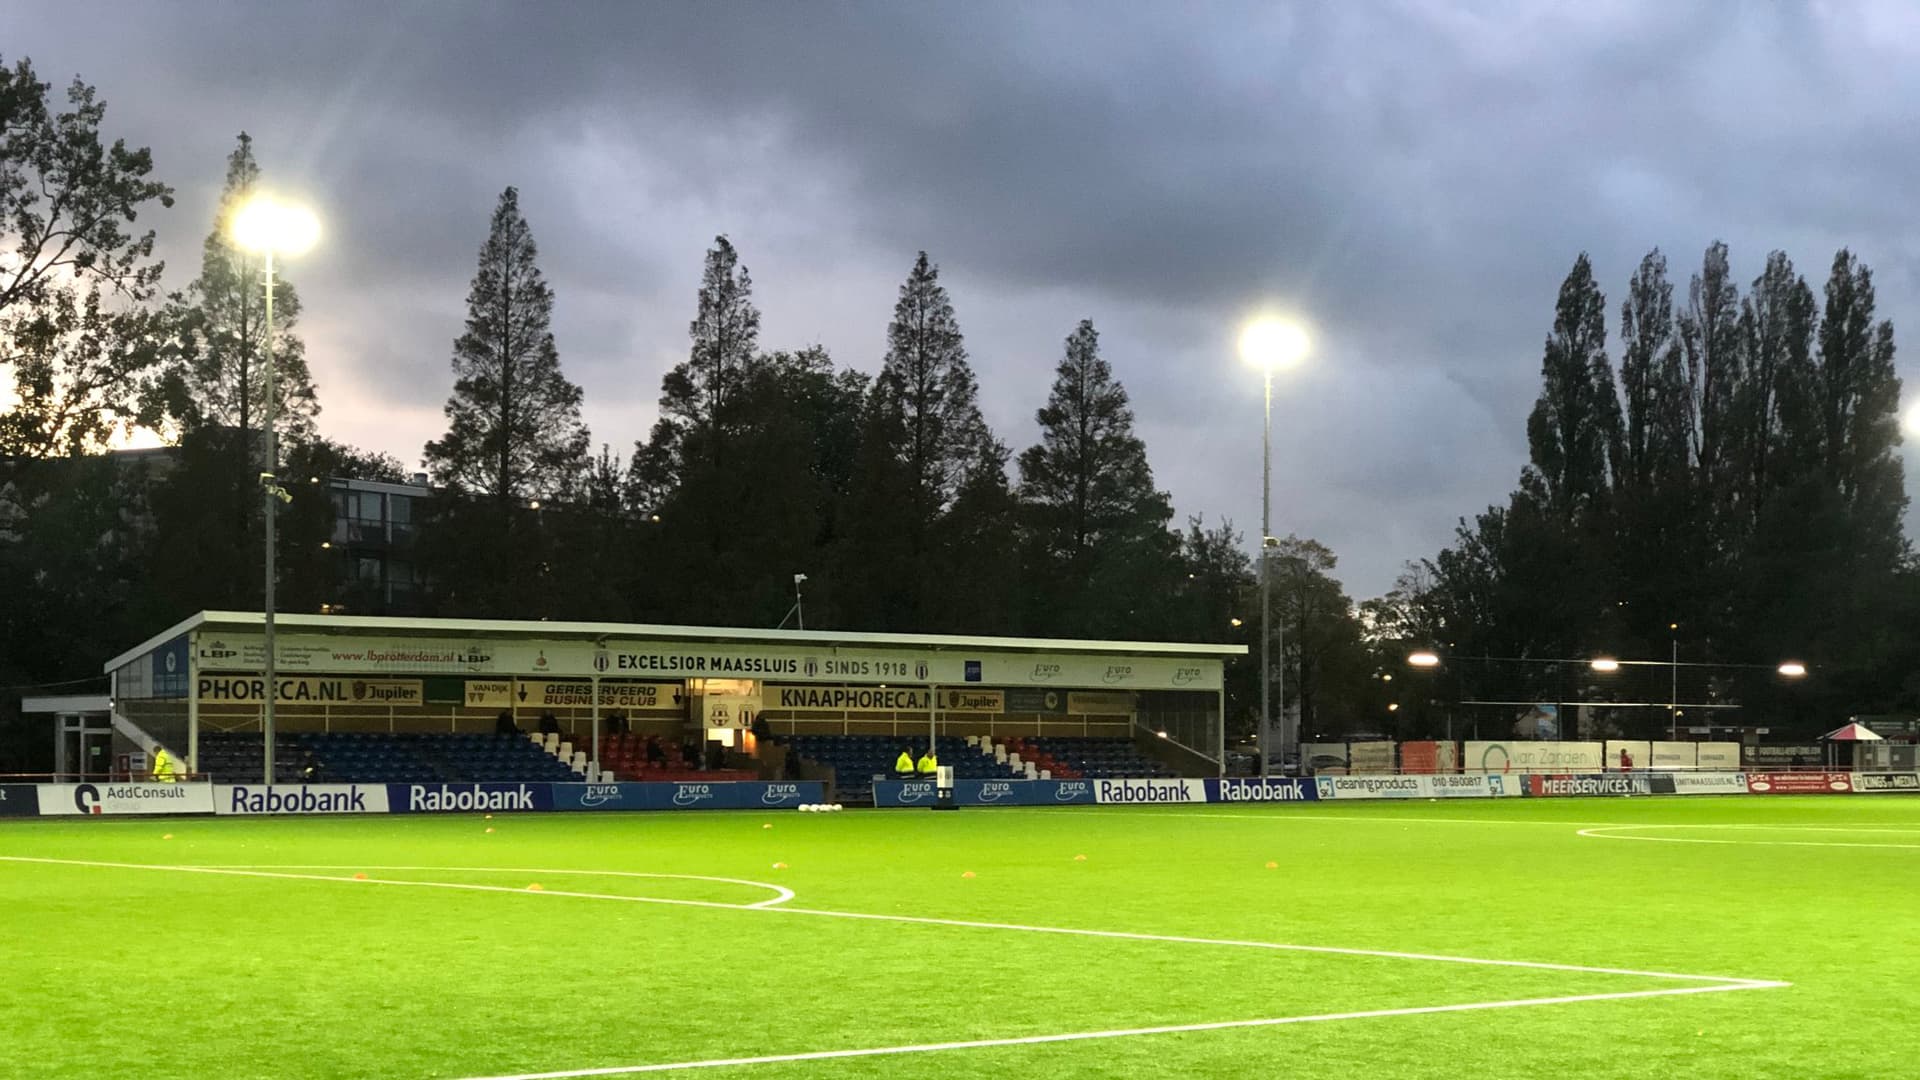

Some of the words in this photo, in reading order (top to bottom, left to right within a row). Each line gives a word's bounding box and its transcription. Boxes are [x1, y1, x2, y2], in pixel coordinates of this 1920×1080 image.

[200, 649, 238, 658] LBP
[331, 650, 455, 664] www.lbprotterdam.nl
[458, 653, 491, 663] LBP
[617, 654, 705, 671] EXCELSIOR
[710, 657, 797, 673] MAASSLUIS
[825, 661, 869, 675] SINDS
[874, 663, 907, 676] 1918
[368, 684, 418, 703] Jupiler
[473, 684, 492, 692] VAN
[545, 684, 656, 696] GERESERVEERD
[543, 695, 615, 705] BUSINESS
[619, 696, 656, 706] CLUB
[781, 688, 946, 709] KNAAPHORECA.NL
[961, 695, 999, 709] Jupiler
[1513, 752, 1536, 764] van
[1538, 747, 1587, 764] Zanden
[106, 786, 186, 799] AddConsult
[586, 785, 618, 800] Euro
[679, 784, 709, 799] Euro
[767, 783, 797, 798] Euro
[903, 783, 931, 797] Euro
[983, 782, 1009, 796] Euro
[1059, 781, 1085, 795] Euro
[1101, 779, 1191, 802] Rabobank
[1220, 778, 1305, 801] Rabobank
[1335, 777, 1374, 792] cleaning
[1375, 777, 1418, 793] products
[1541, 778, 1648, 794] MEERSERVICES.NL
[231, 785, 365, 812] Rabobank
[409, 783, 534, 811] Rabobank
